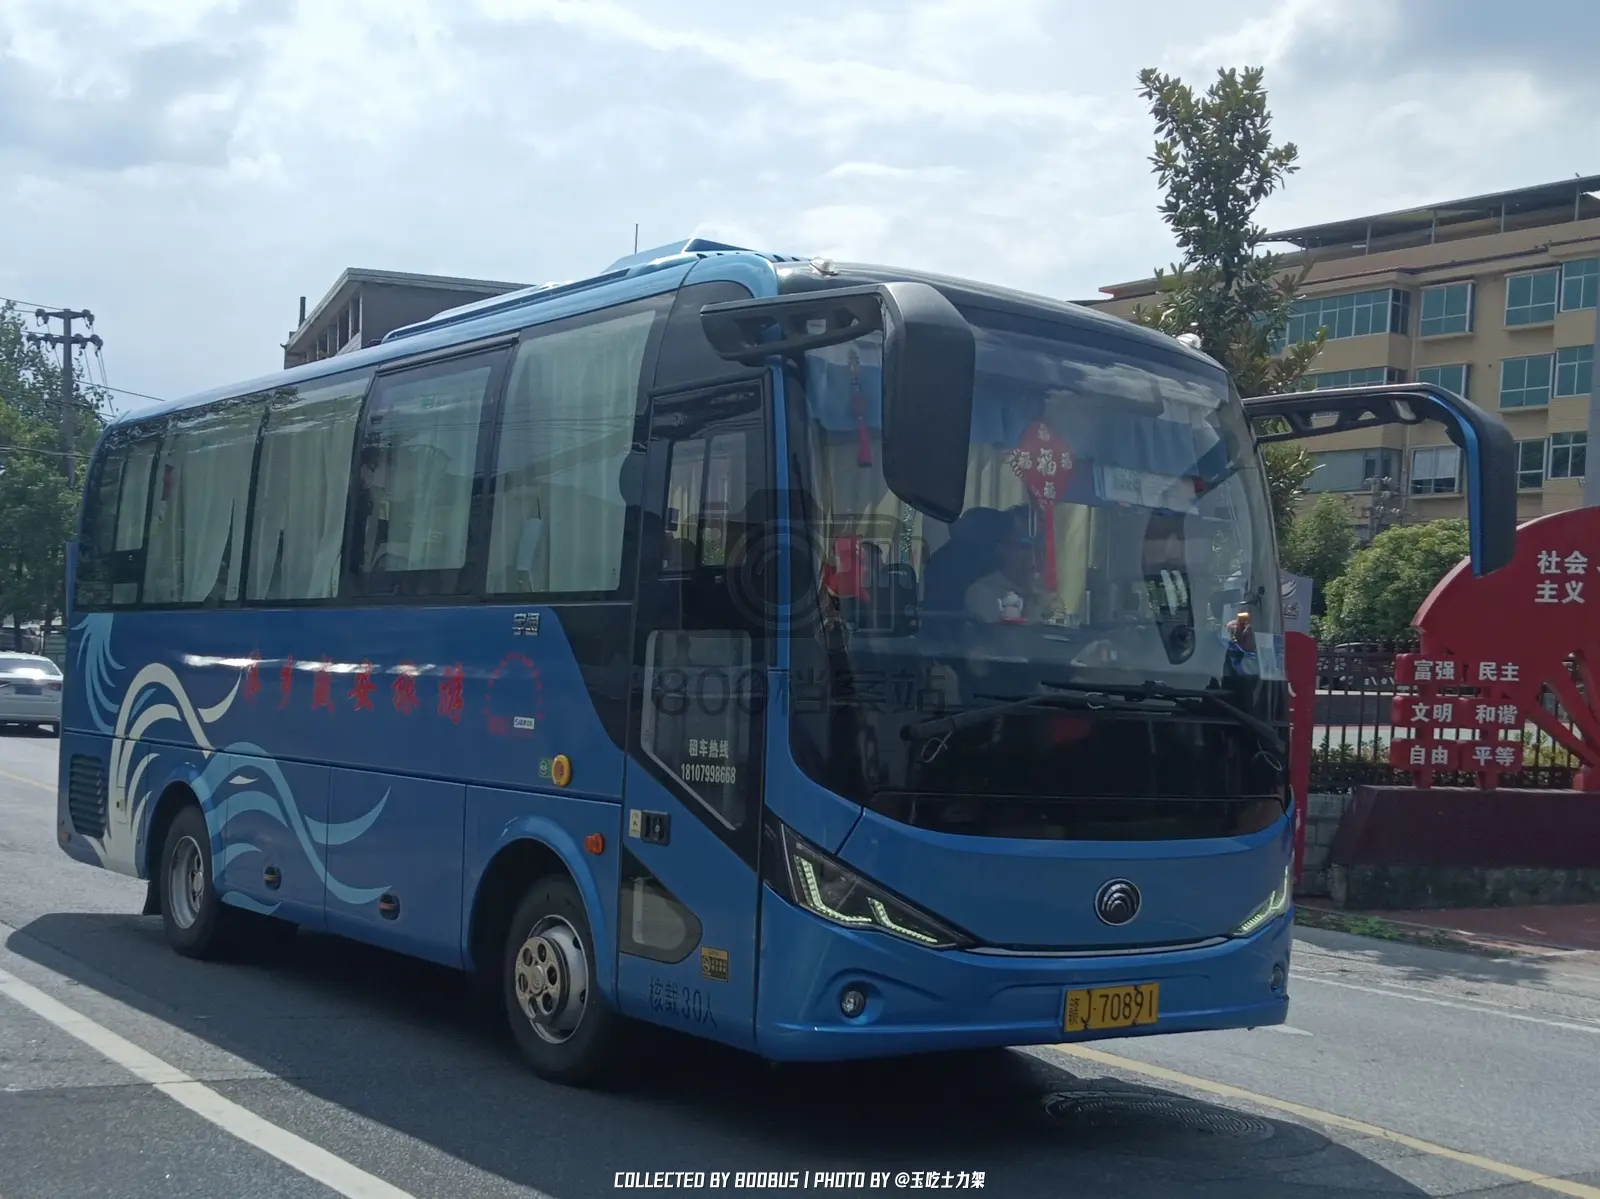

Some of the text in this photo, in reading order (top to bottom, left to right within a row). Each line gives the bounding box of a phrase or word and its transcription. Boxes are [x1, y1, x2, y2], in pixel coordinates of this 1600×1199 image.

[1037, 448, 1057, 477] 福
[1538, 550, 1588, 576] 社会
[1535, 580, 1585, 605] 主义
[1414, 659, 1455, 682] 富强
[1478, 662, 1520, 683] 民主
[1410, 703, 1453, 723] 文明
[1475, 705, 1518, 726] 和谐
[688, 739, 729, 759] 租车热线
[1409, 745, 1449, 766] 自由
[1472, 747, 1515, 767] 平等
[681, 763, 737, 785] 18107998668
[649, 977, 718, 1029] 核载30人
